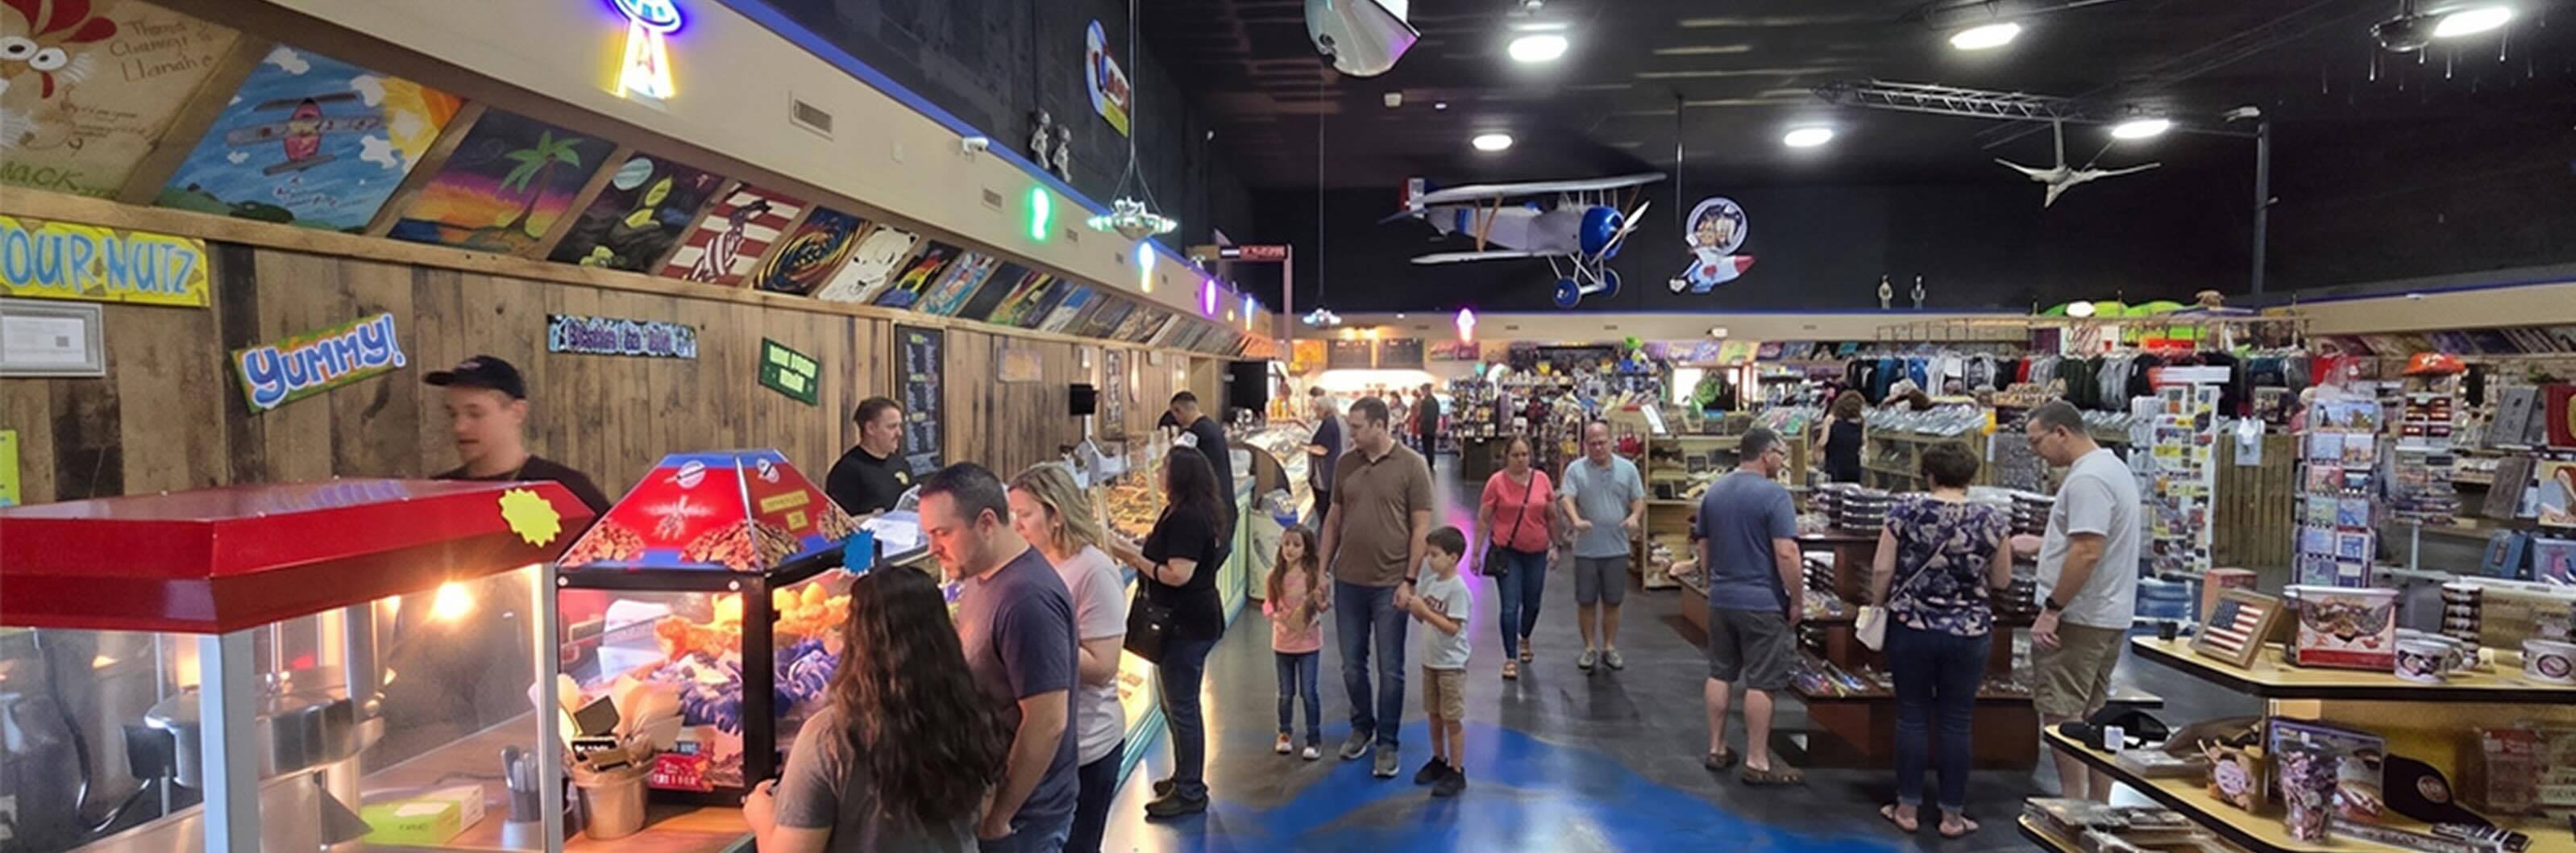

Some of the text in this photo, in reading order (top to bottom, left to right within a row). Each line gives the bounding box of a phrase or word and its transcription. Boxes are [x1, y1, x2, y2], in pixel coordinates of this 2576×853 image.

[0, 226, 196, 294] OUR NUTZ
[243, 313, 406, 409] YUMMY!
